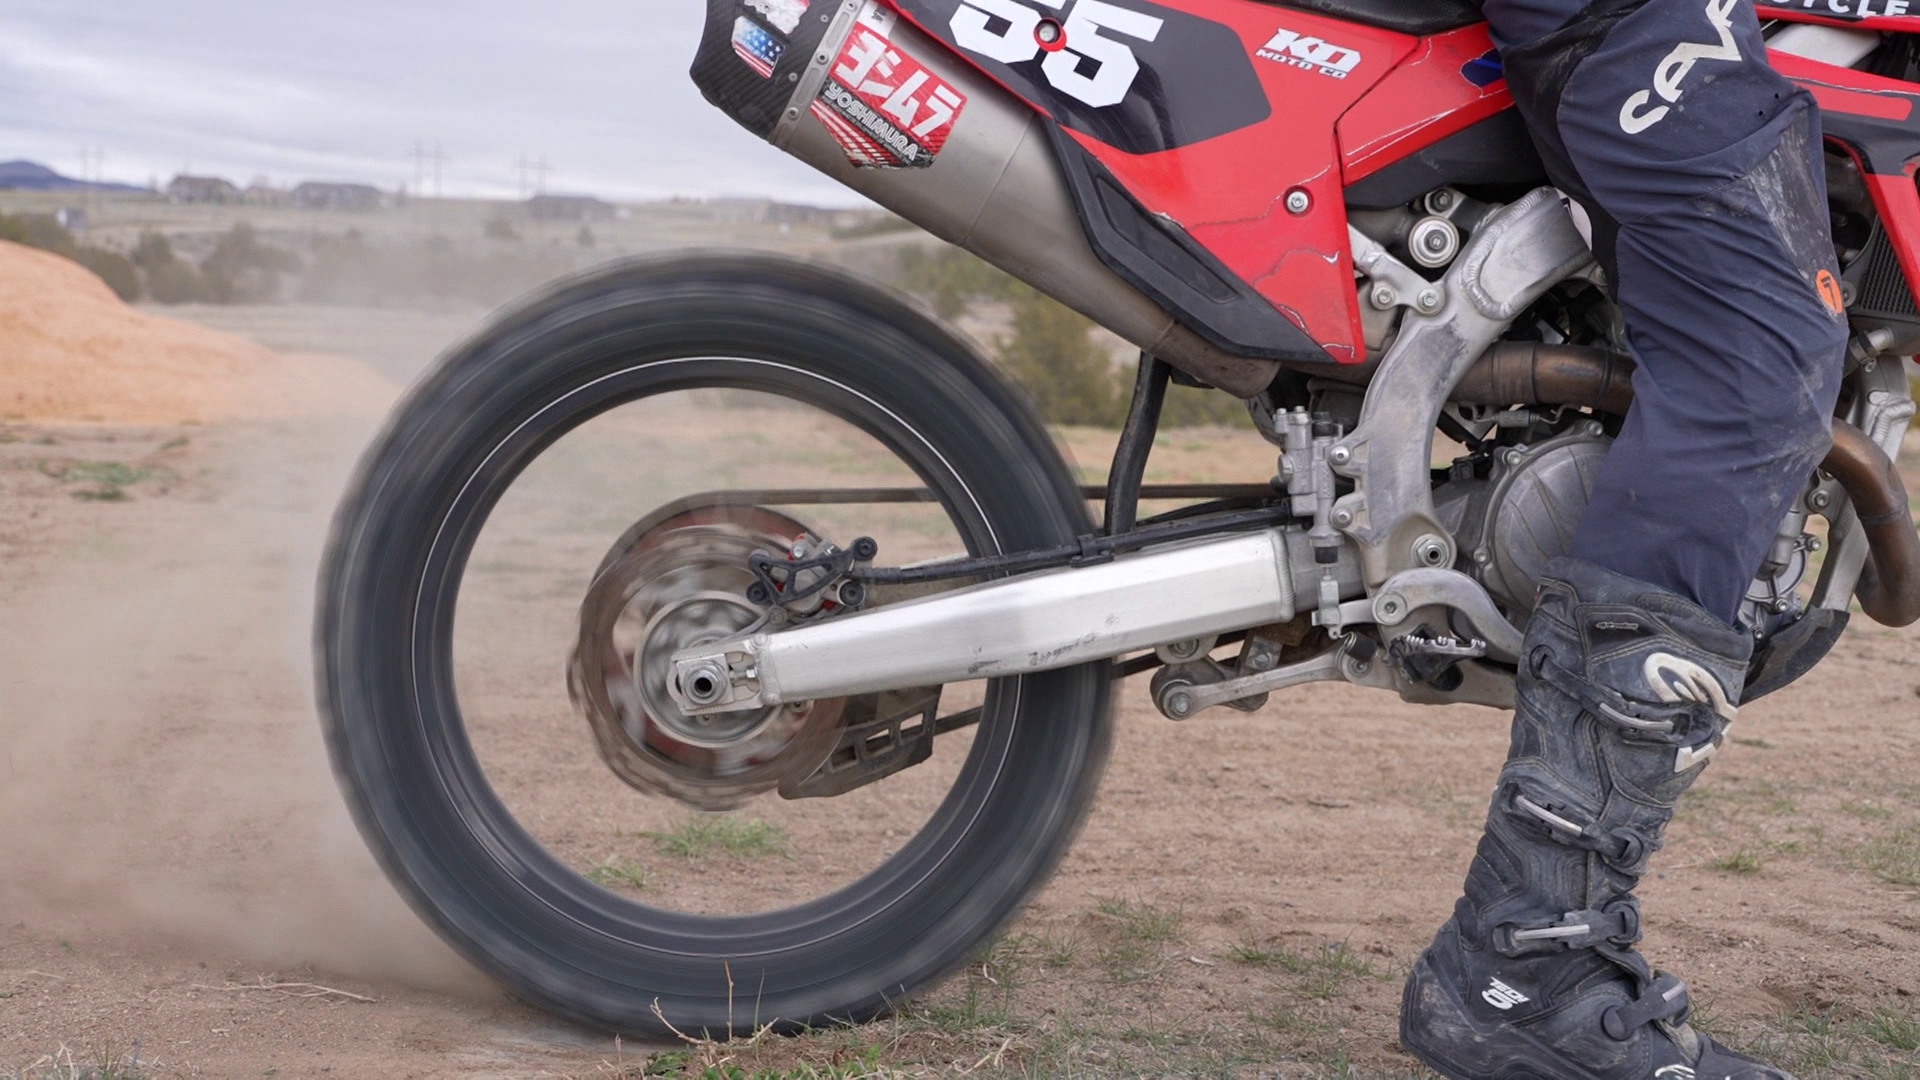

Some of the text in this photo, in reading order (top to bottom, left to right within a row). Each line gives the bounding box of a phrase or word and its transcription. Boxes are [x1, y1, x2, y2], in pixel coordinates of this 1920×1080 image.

[834, 30, 963, 139] ヨシムラ
[949, 0, 1164, 108] 55
[1255, 48, 1314, 71] MOTO
[1263, 27, 1361, 73] KD
[824, 82, 919, 161] YOSHIMURA
